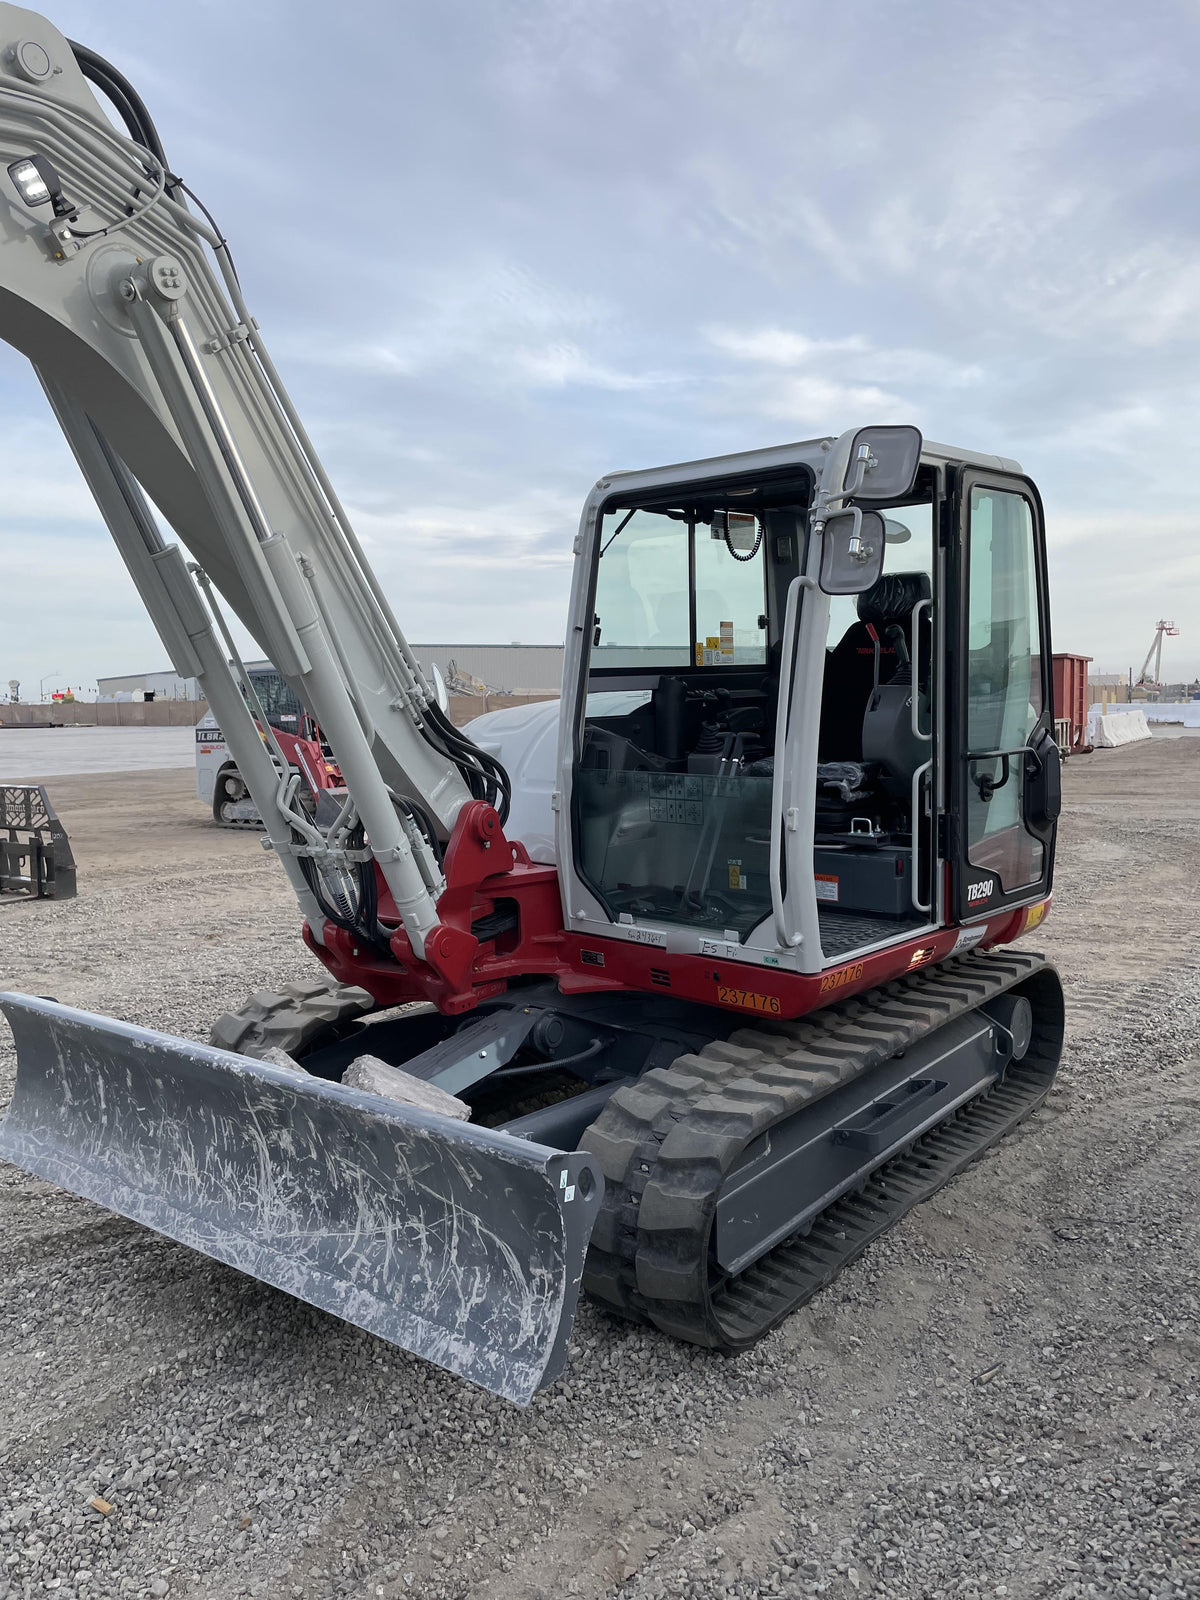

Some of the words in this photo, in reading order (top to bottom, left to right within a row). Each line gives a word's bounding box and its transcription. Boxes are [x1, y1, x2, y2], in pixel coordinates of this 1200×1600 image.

[968, 880, 993, 901] TB290
[821, 964, 863, 992] 237176
[719, 987, 780, 1013] 237176
